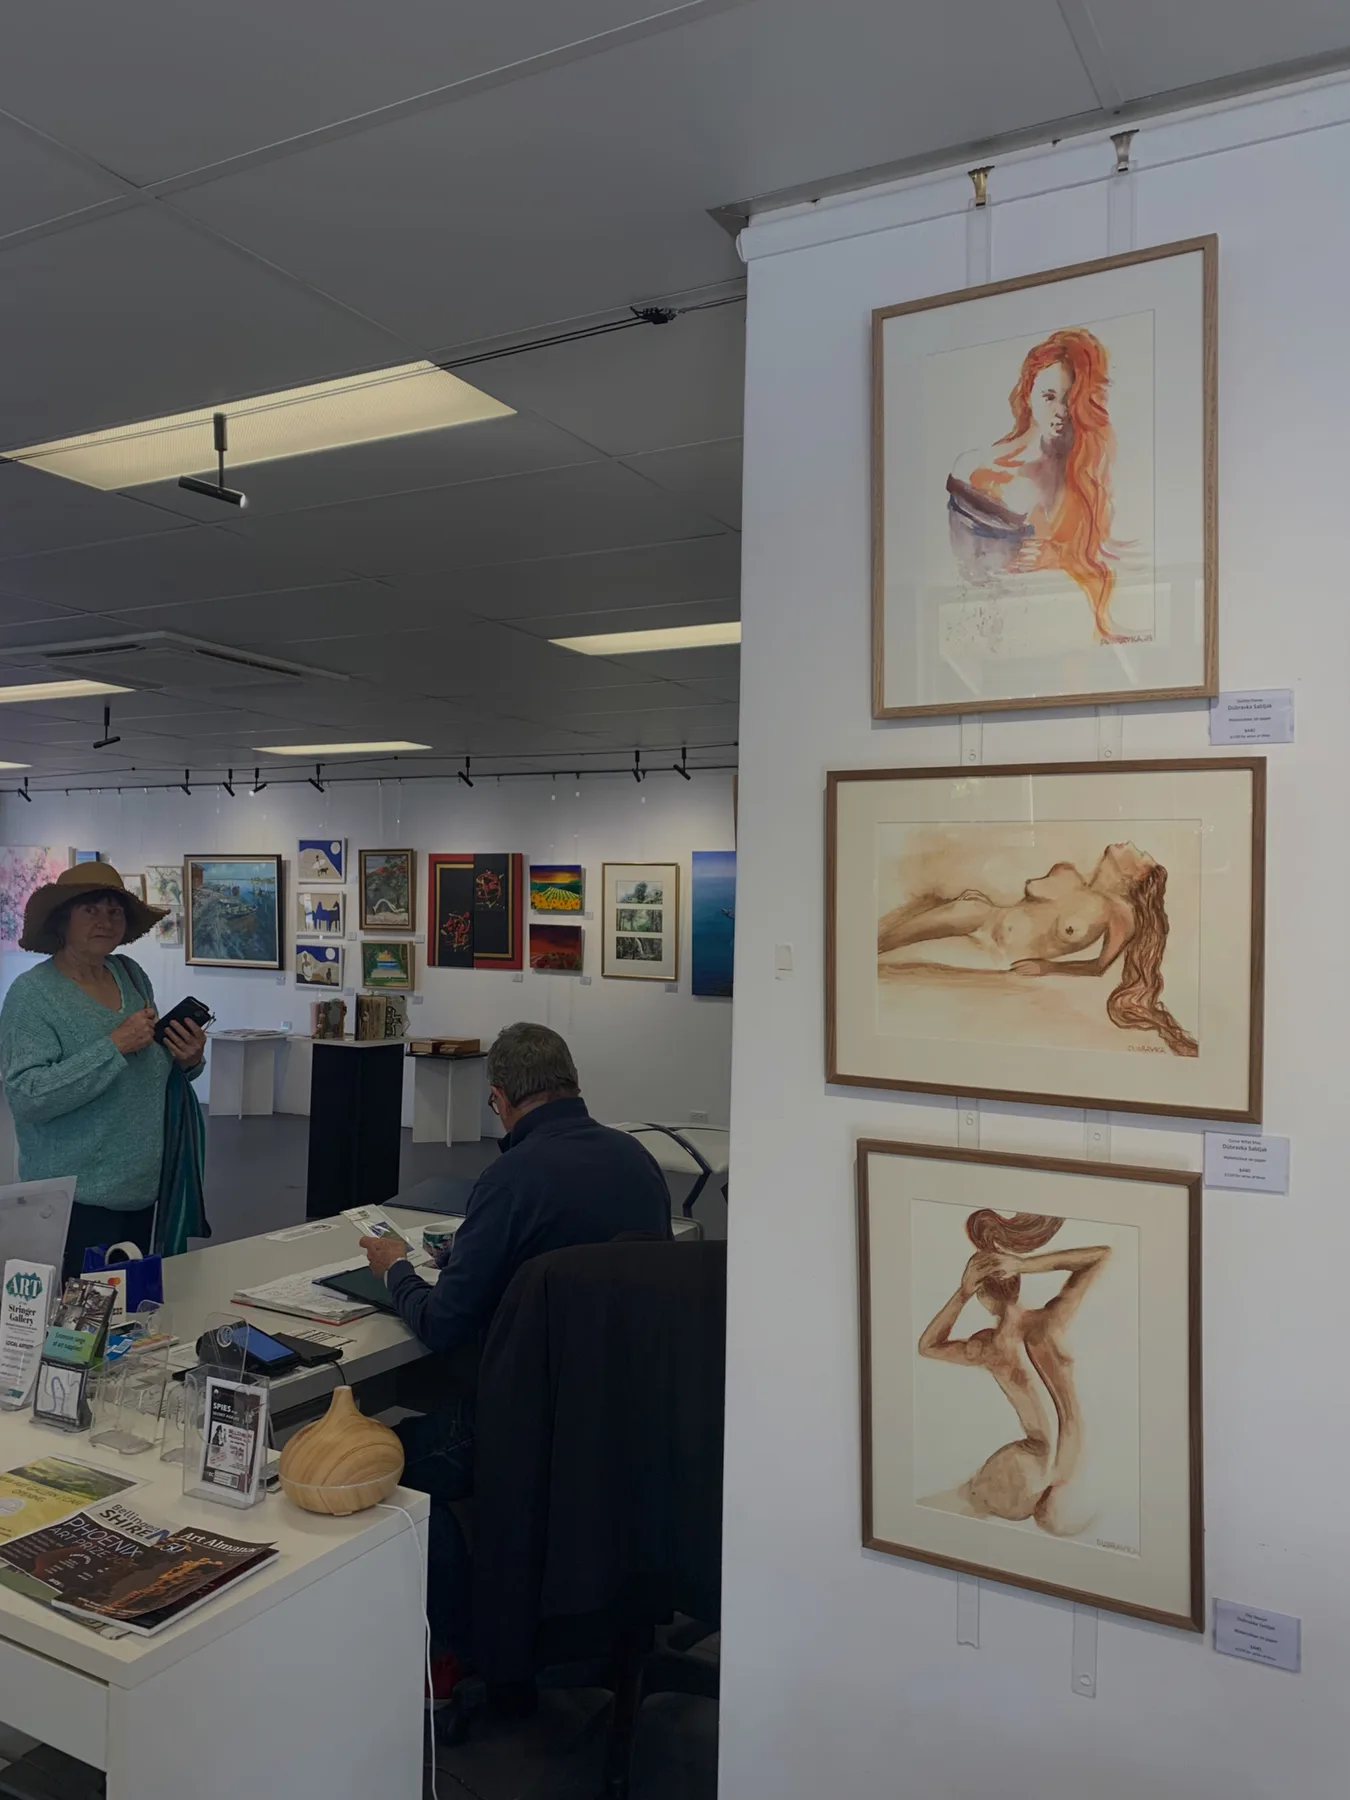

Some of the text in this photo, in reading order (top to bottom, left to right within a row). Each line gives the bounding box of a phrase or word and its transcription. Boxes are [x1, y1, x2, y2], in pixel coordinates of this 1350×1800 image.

[10, 1276, 40, 1297] ART
[8, 1304, 36, 1316] Stringer
[9, 1313, 33, 1326] Gallery
[213, 1402, 231, 1413] SPIES
[99, 1509, 150, 1538] SHIRE
[112, 1504, 160, 1531] Bellingen
[49, 1527, 76, 1541] ART
[72, 1538, 112, 1558] PRIZE
[64, 1517, 140, 1557] PHOENIX
[180, 1532, 206, 1543] Art
